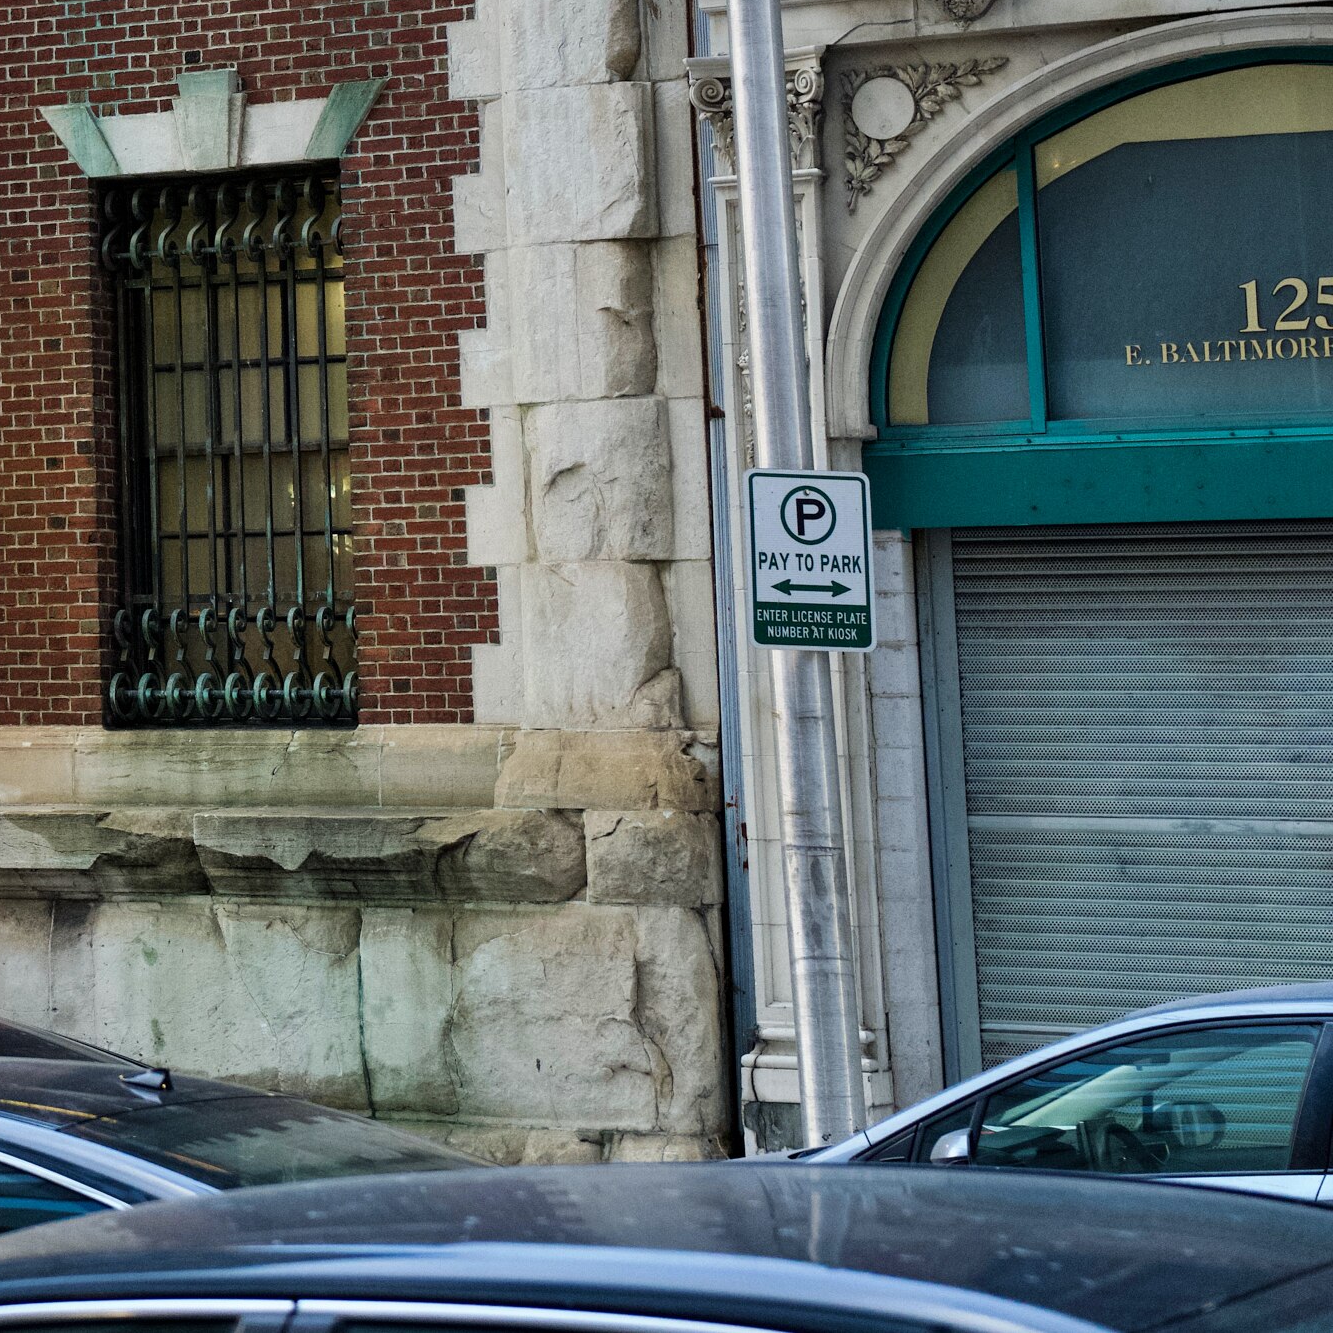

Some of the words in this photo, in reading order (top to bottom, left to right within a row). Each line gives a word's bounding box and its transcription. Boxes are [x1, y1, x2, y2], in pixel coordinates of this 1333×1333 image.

[1125, 344, 1151, 366] E.
[795, 498, 826, 536] P
[758, 551, 790, 570] PAY
[795, 553, 814, 572] TO
[821, 554, 862, 574] PARK
[757, 609, 788, 622] ENTER
[792, 610, 833, 624] LICENSE
[837, 612, 868, 625] PLATE
[767, 625, 809, 639] NUMBER
[812, 627, 824, 639] AT
[828, 627, 858, 640] KIOSK
